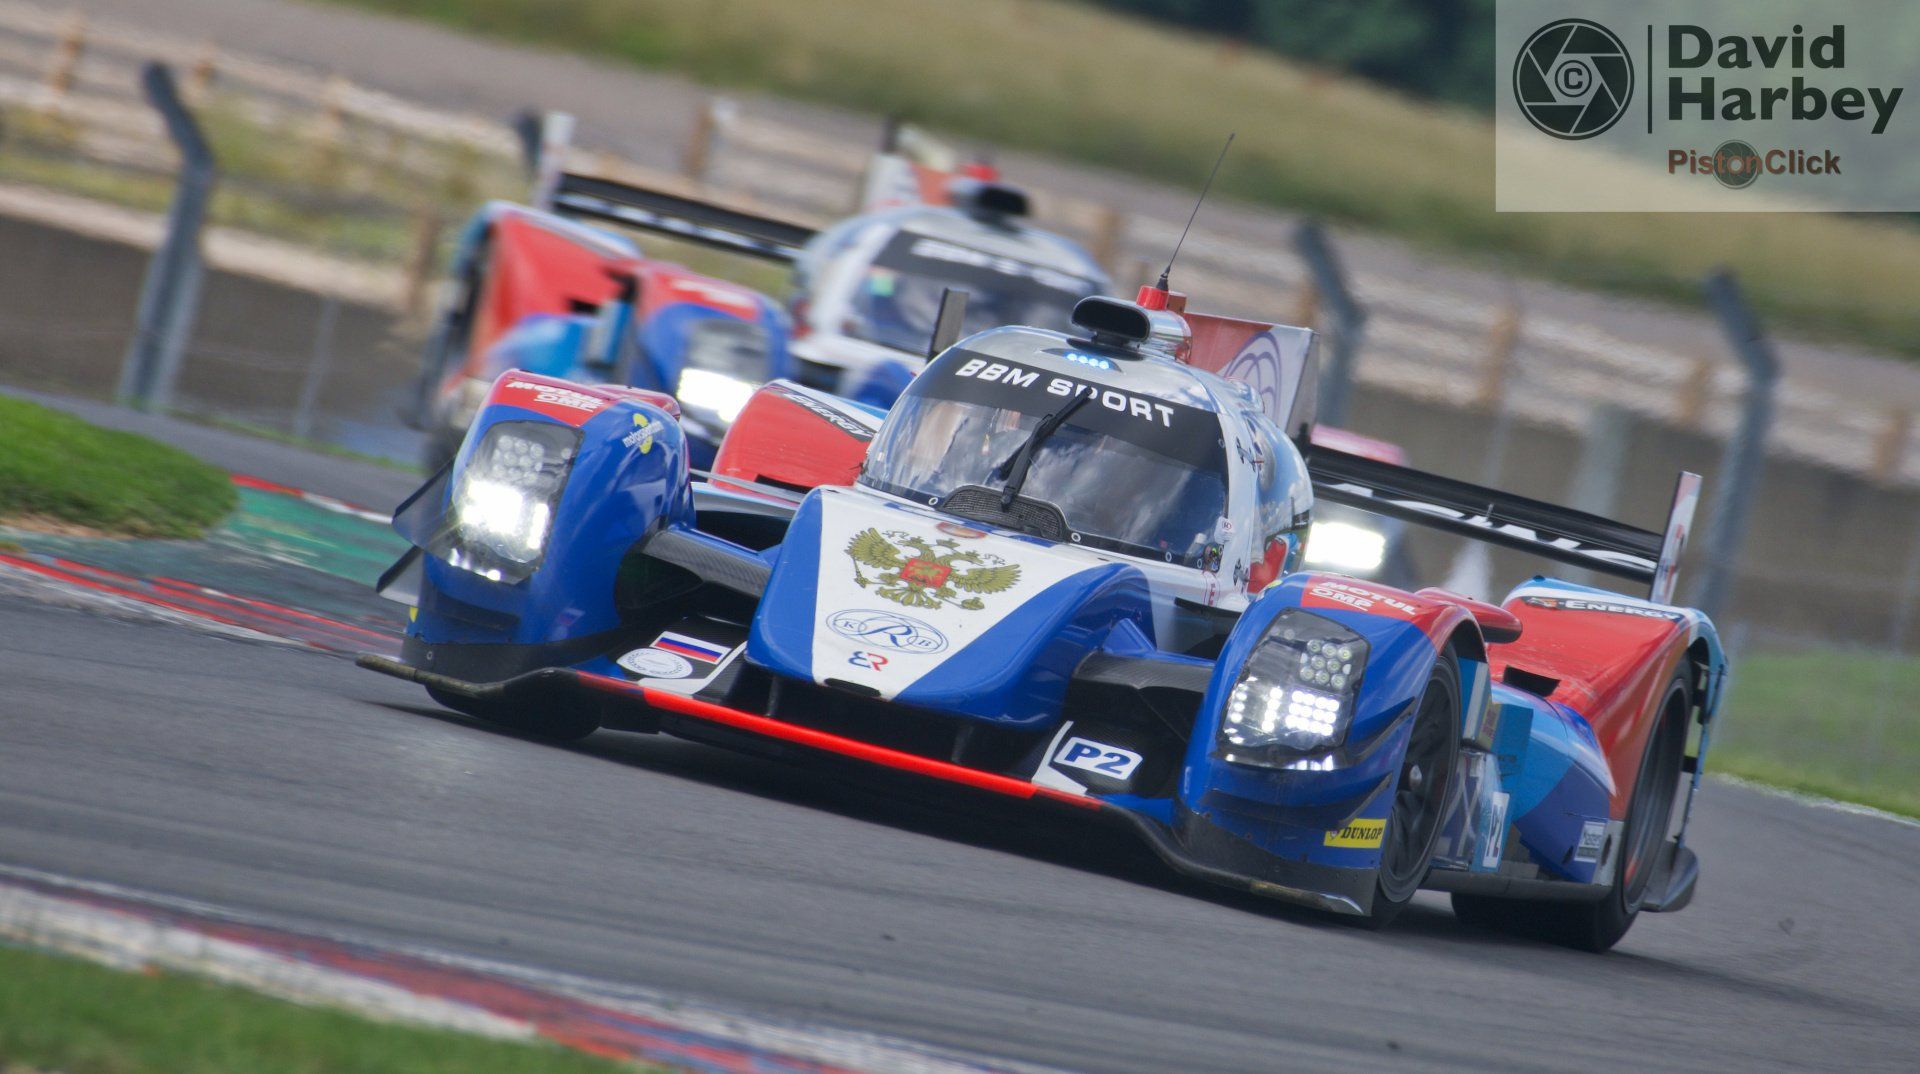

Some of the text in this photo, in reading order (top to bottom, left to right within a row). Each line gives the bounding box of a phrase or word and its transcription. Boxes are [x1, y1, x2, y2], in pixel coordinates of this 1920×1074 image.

[955, 359, 1175, 427] BBM SPORT
[1311, 587, 1375, 609] OMP
[1319, 581, 1416, 615] MOTUL
[1063, 742, 1131, 775] P2
[1340, 826, 1383, 841] DUNLOP
